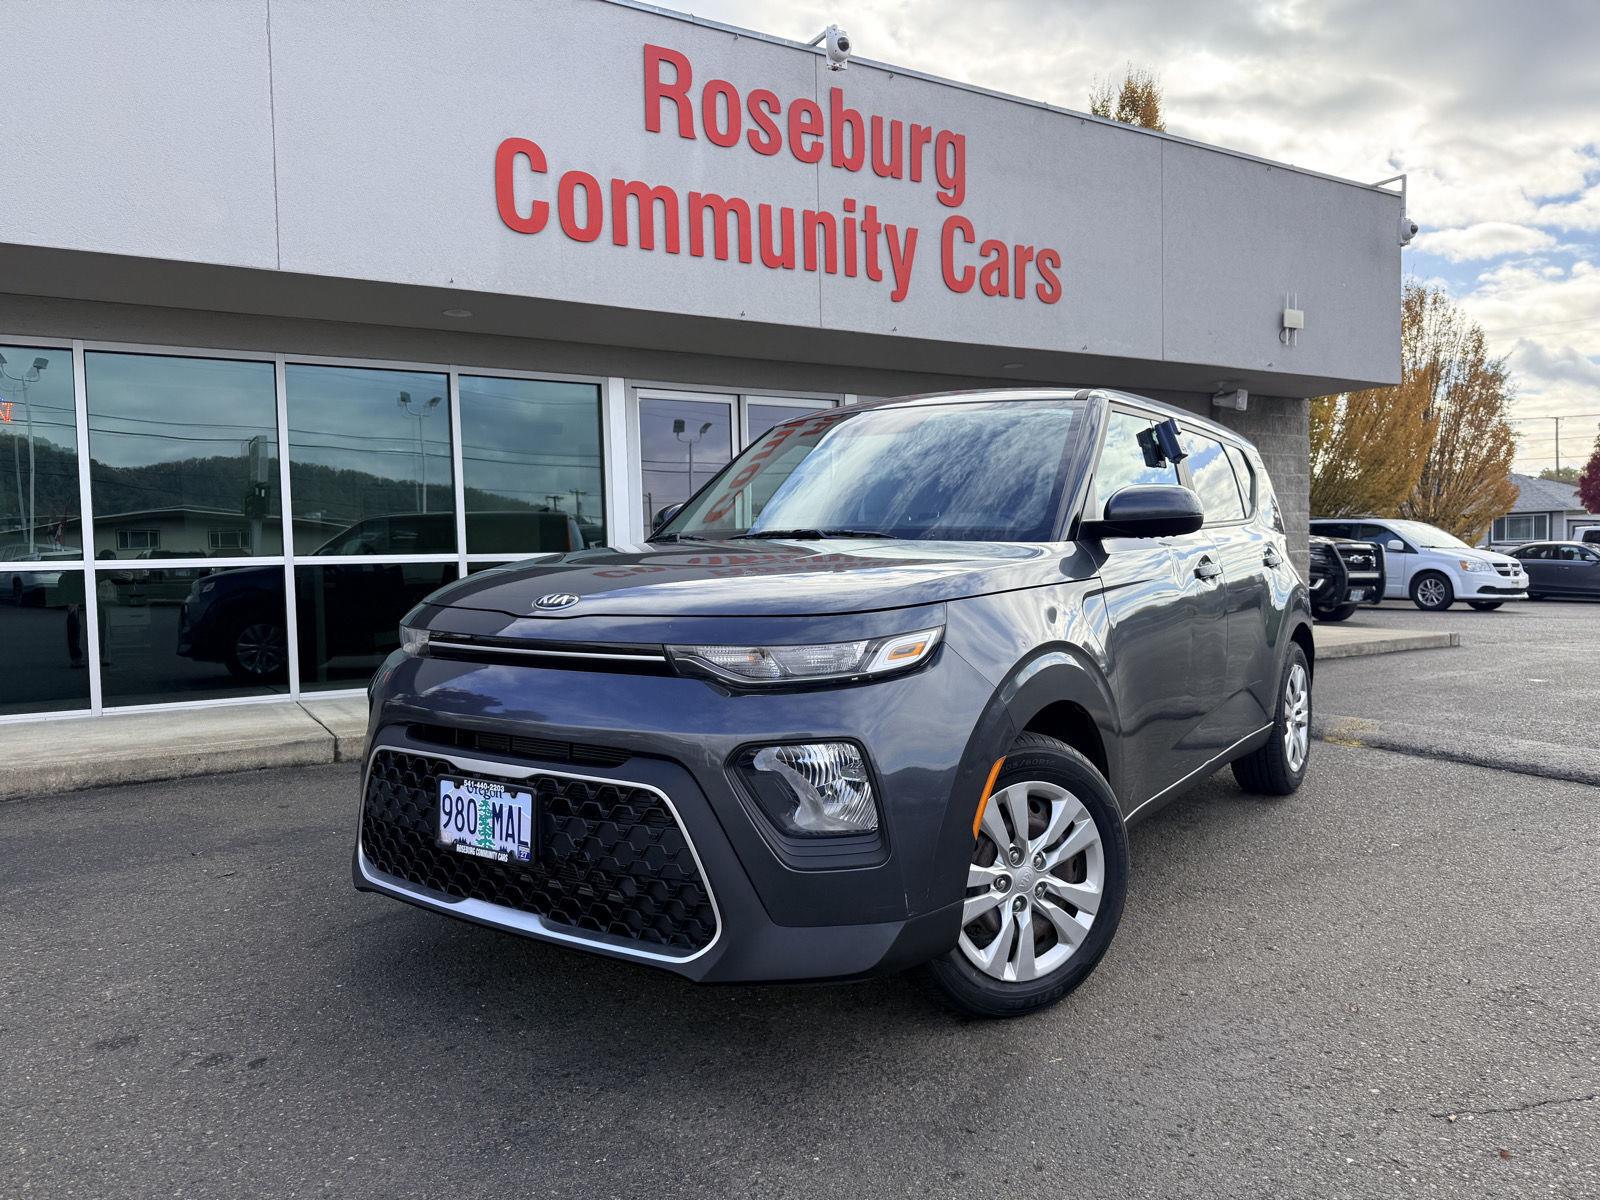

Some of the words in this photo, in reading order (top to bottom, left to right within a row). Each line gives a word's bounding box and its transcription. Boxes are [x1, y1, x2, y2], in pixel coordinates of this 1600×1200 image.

[643, 43, 966, 207] Roseburg
[495, 137, 919, 302] Community
[941, 215, 1062, 304] Cars
[442, 793, 478, 835] 980
[492, 801, 529, 847] MAL
[463, 779, 505, 793] 541-440-2203
